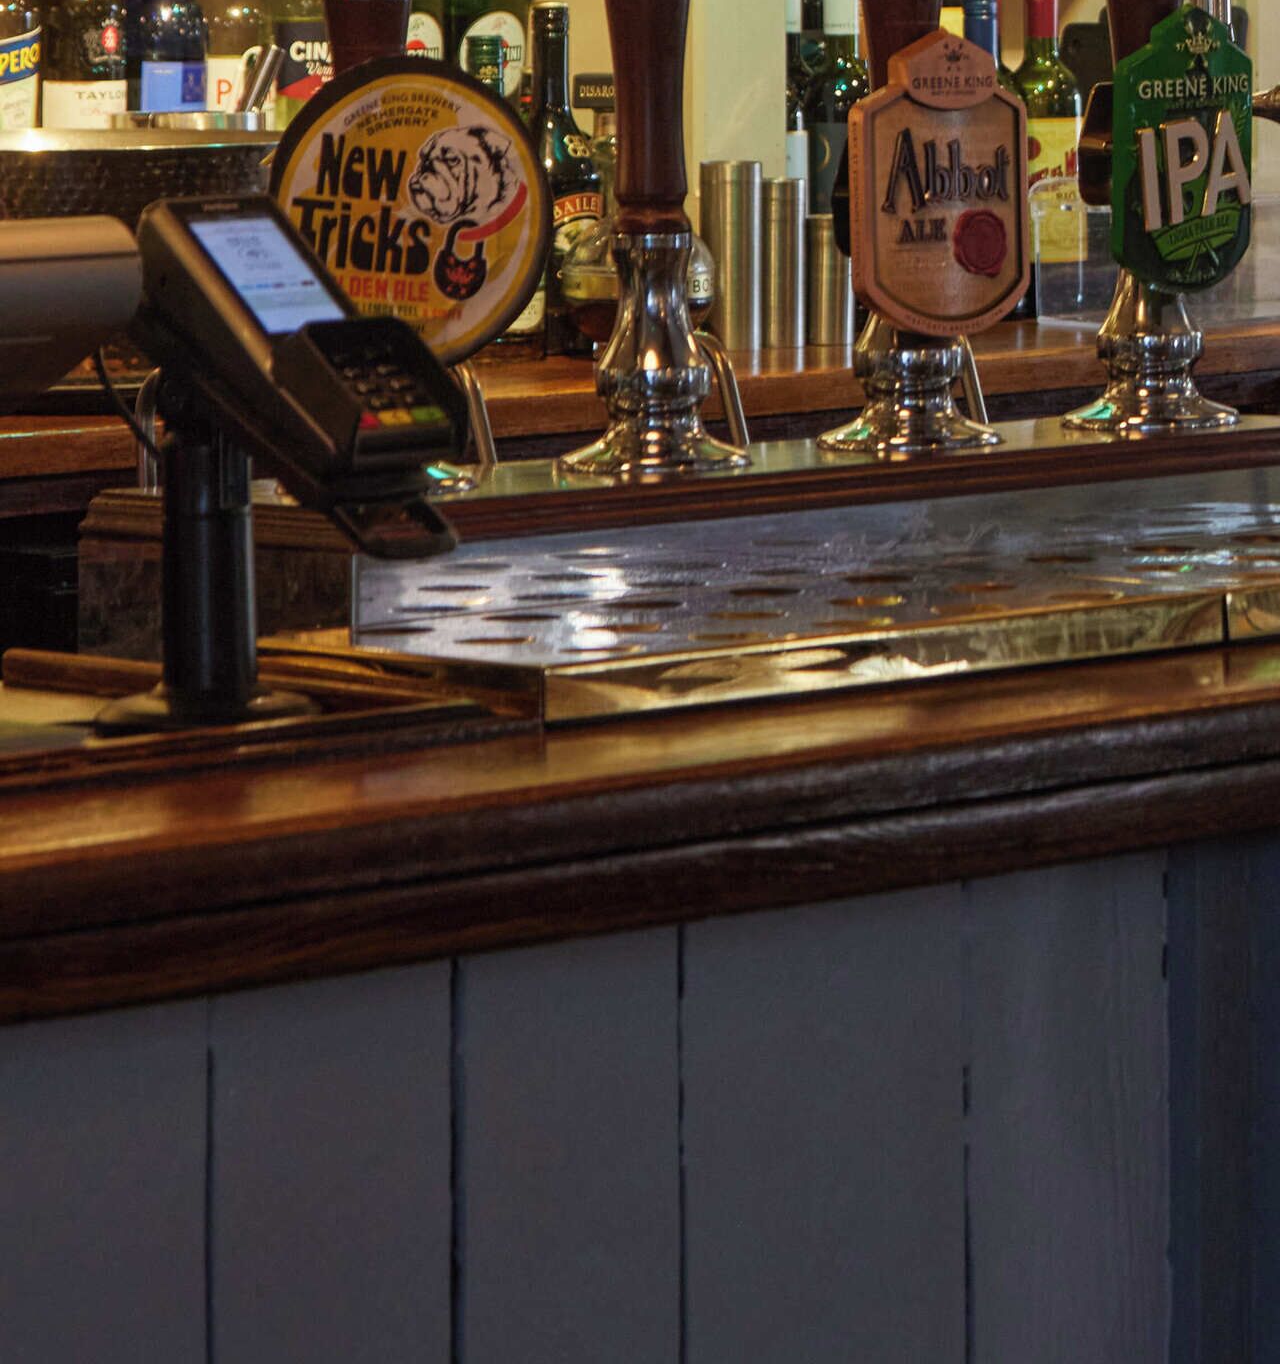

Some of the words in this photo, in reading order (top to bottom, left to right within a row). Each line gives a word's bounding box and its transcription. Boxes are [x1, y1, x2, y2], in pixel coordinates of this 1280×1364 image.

[290, 40, 334, 63] CIN
[911, 76, 961, 90] GREENE
[964, 75, 993, 88] KING
[1138, 75, 1208, 100] GREENE
[1213, 74, 1249, 94] KING
[410, 91, 463, 114] BREWERY
[356, 106, 439, 132] NETHERGATE
[365, 118, 430, 136] BREWERY
[316, 132, 407, 202] New
[880, 127, 1011, 215] Abbot
[1135, 107, 1251, 234] IPA
[292, 197, 431, 276] Tricks
[897, 219, 947, 244] ALE
[392, 277, 431, 301] ALE
